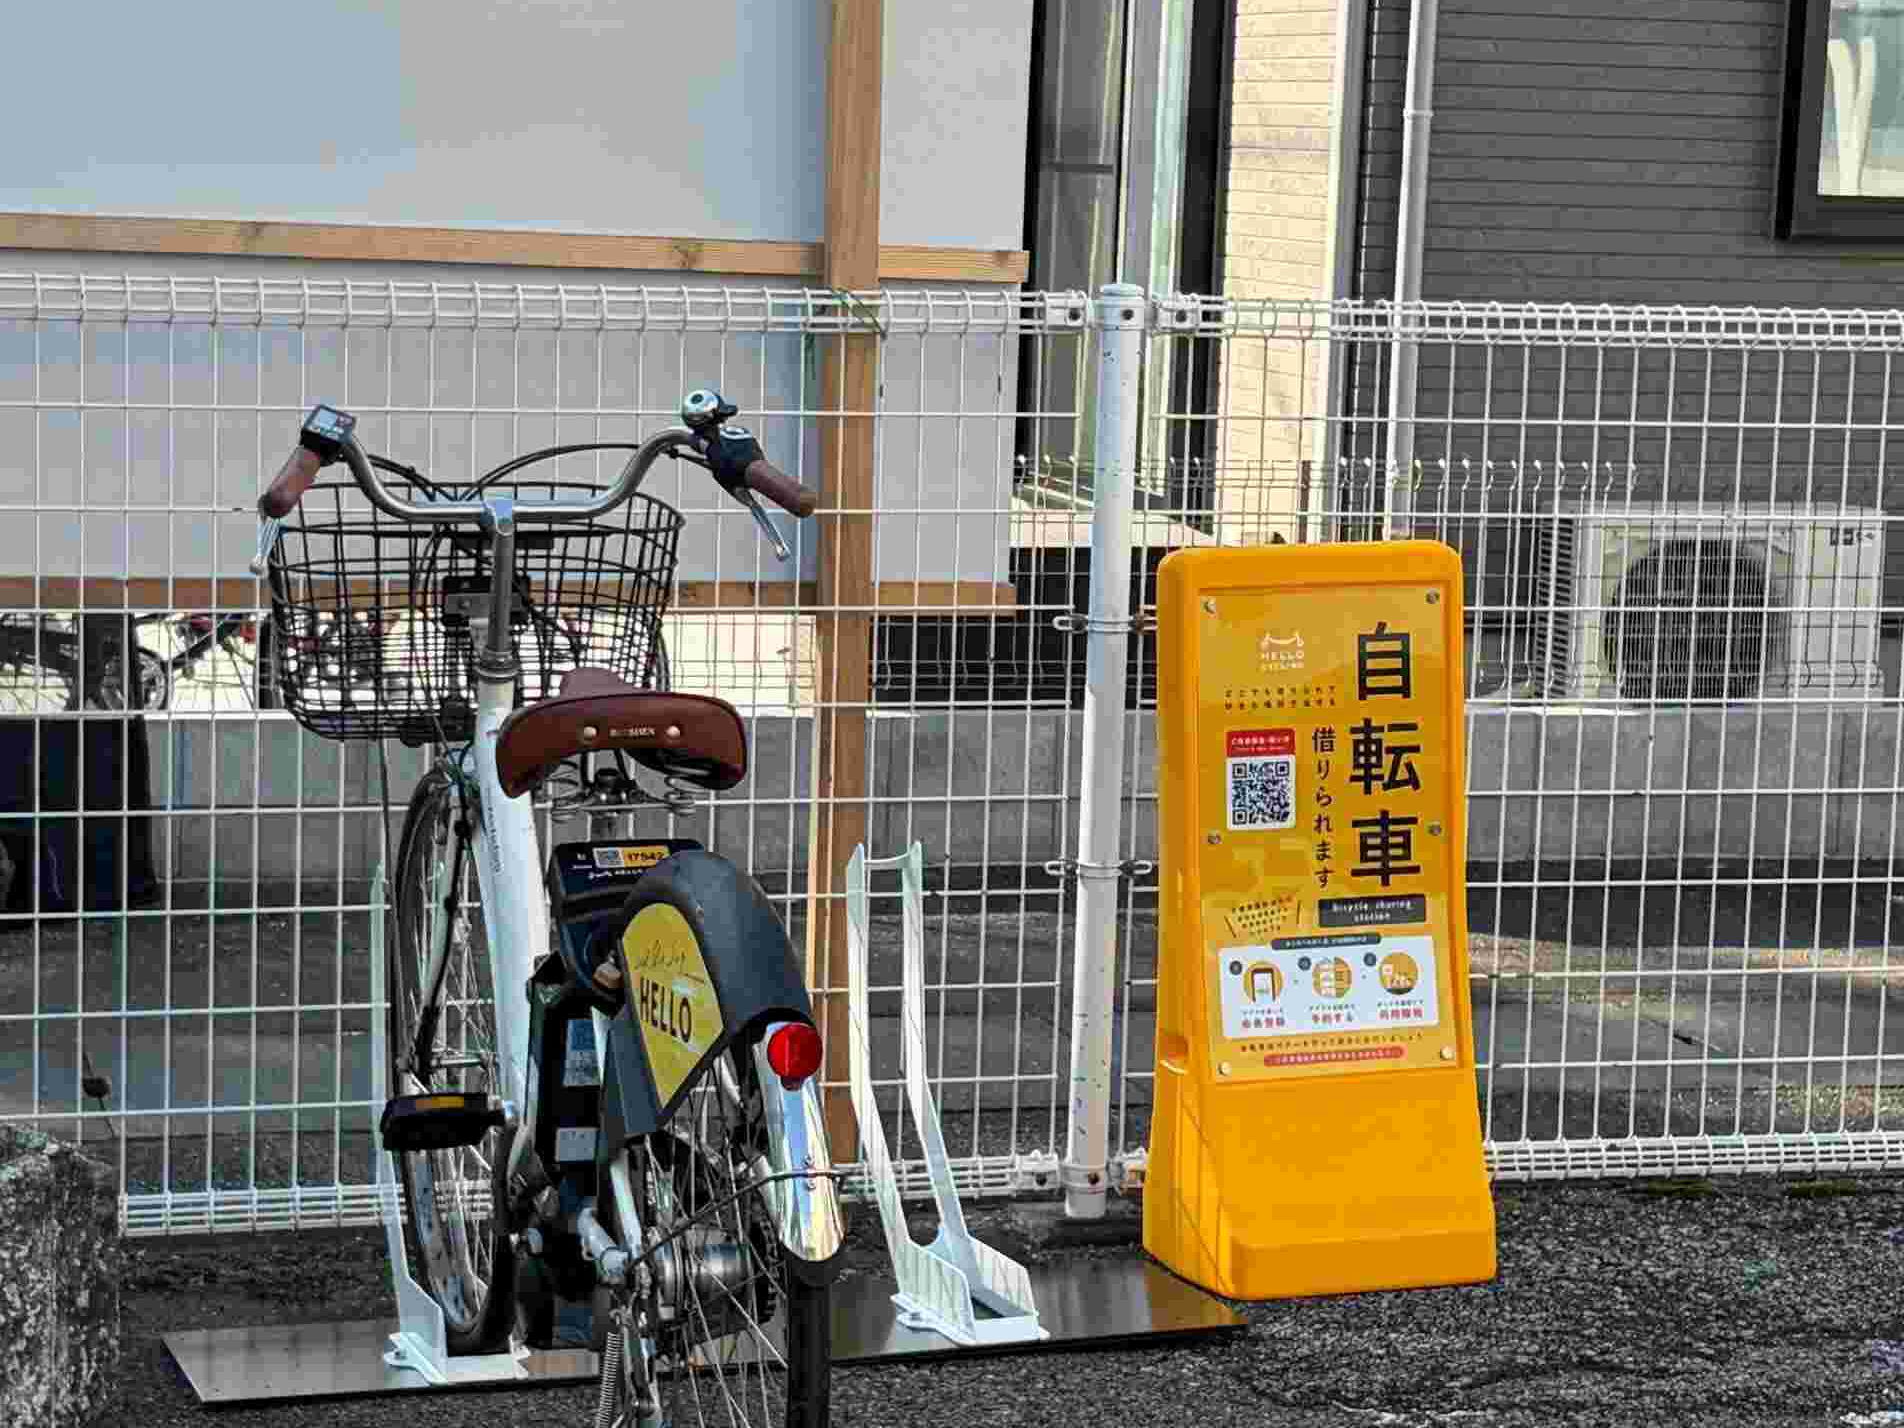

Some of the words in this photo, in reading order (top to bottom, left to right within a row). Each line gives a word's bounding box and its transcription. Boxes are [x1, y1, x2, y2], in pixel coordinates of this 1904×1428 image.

[1312, 725, 1336, 888] 借りられます
[1348, 621, 1422, 888] 自転車
[640, 976, 692, 1043] HELLO
